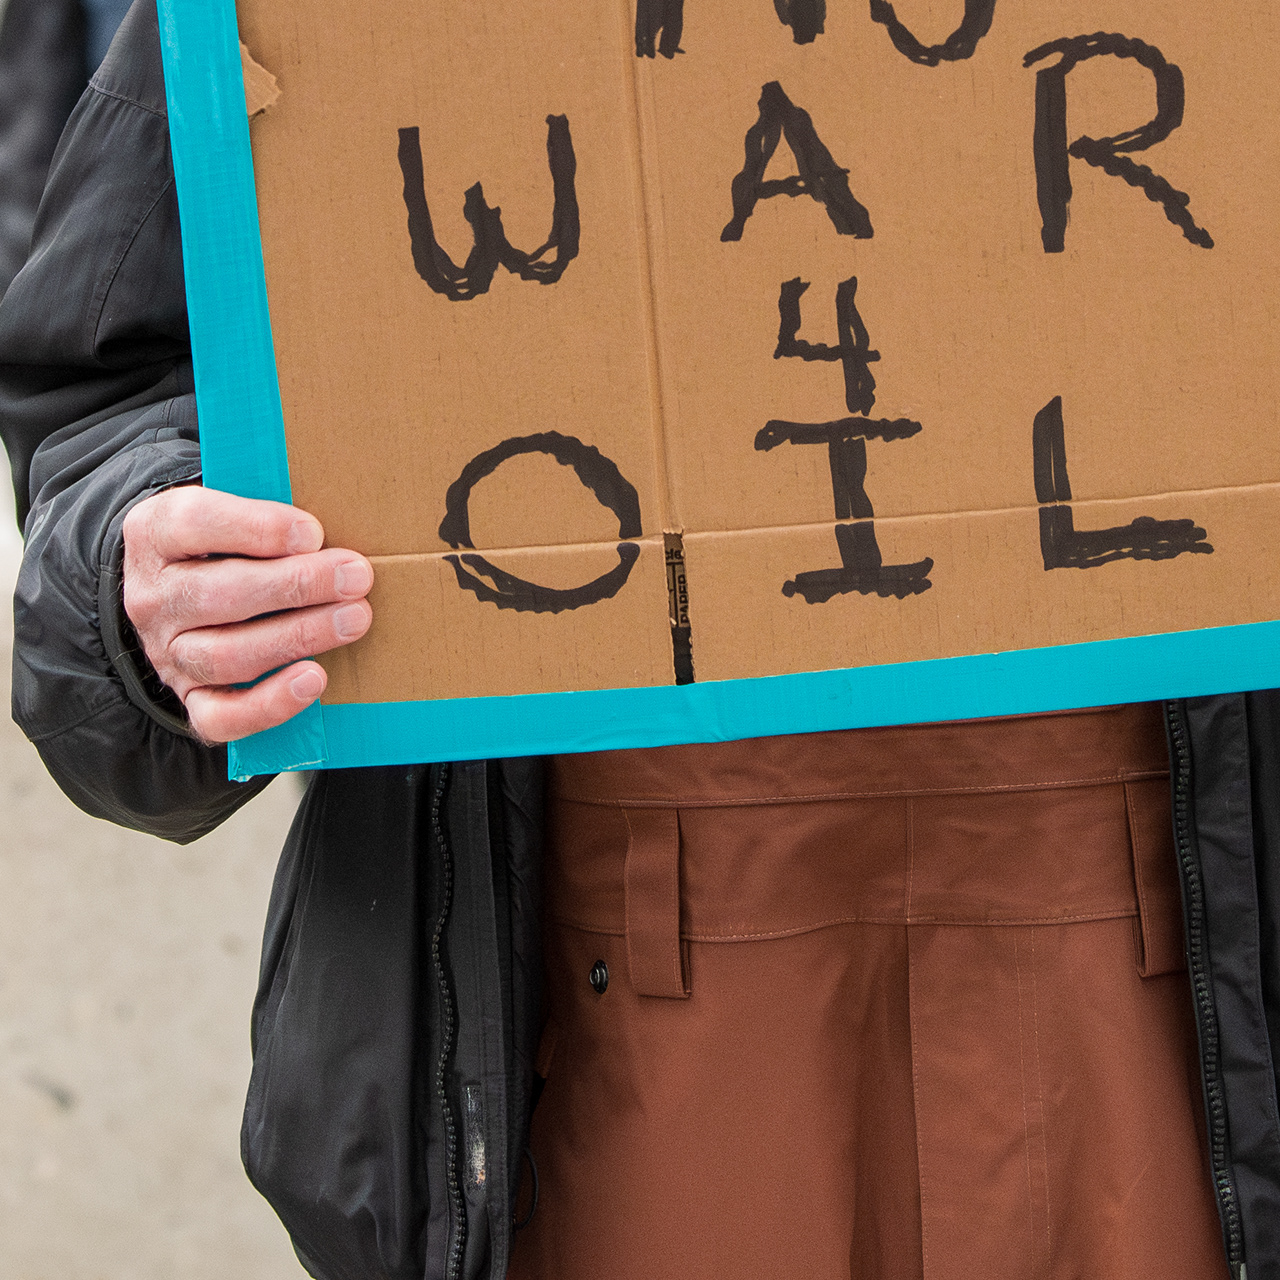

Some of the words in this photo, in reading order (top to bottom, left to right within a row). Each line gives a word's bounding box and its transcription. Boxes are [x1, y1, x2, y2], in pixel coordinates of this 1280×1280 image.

[398, 32, 1214, 301] WAR
[773, 276, 881, 415] 4
[439, 396, 1214, 614] OIL
